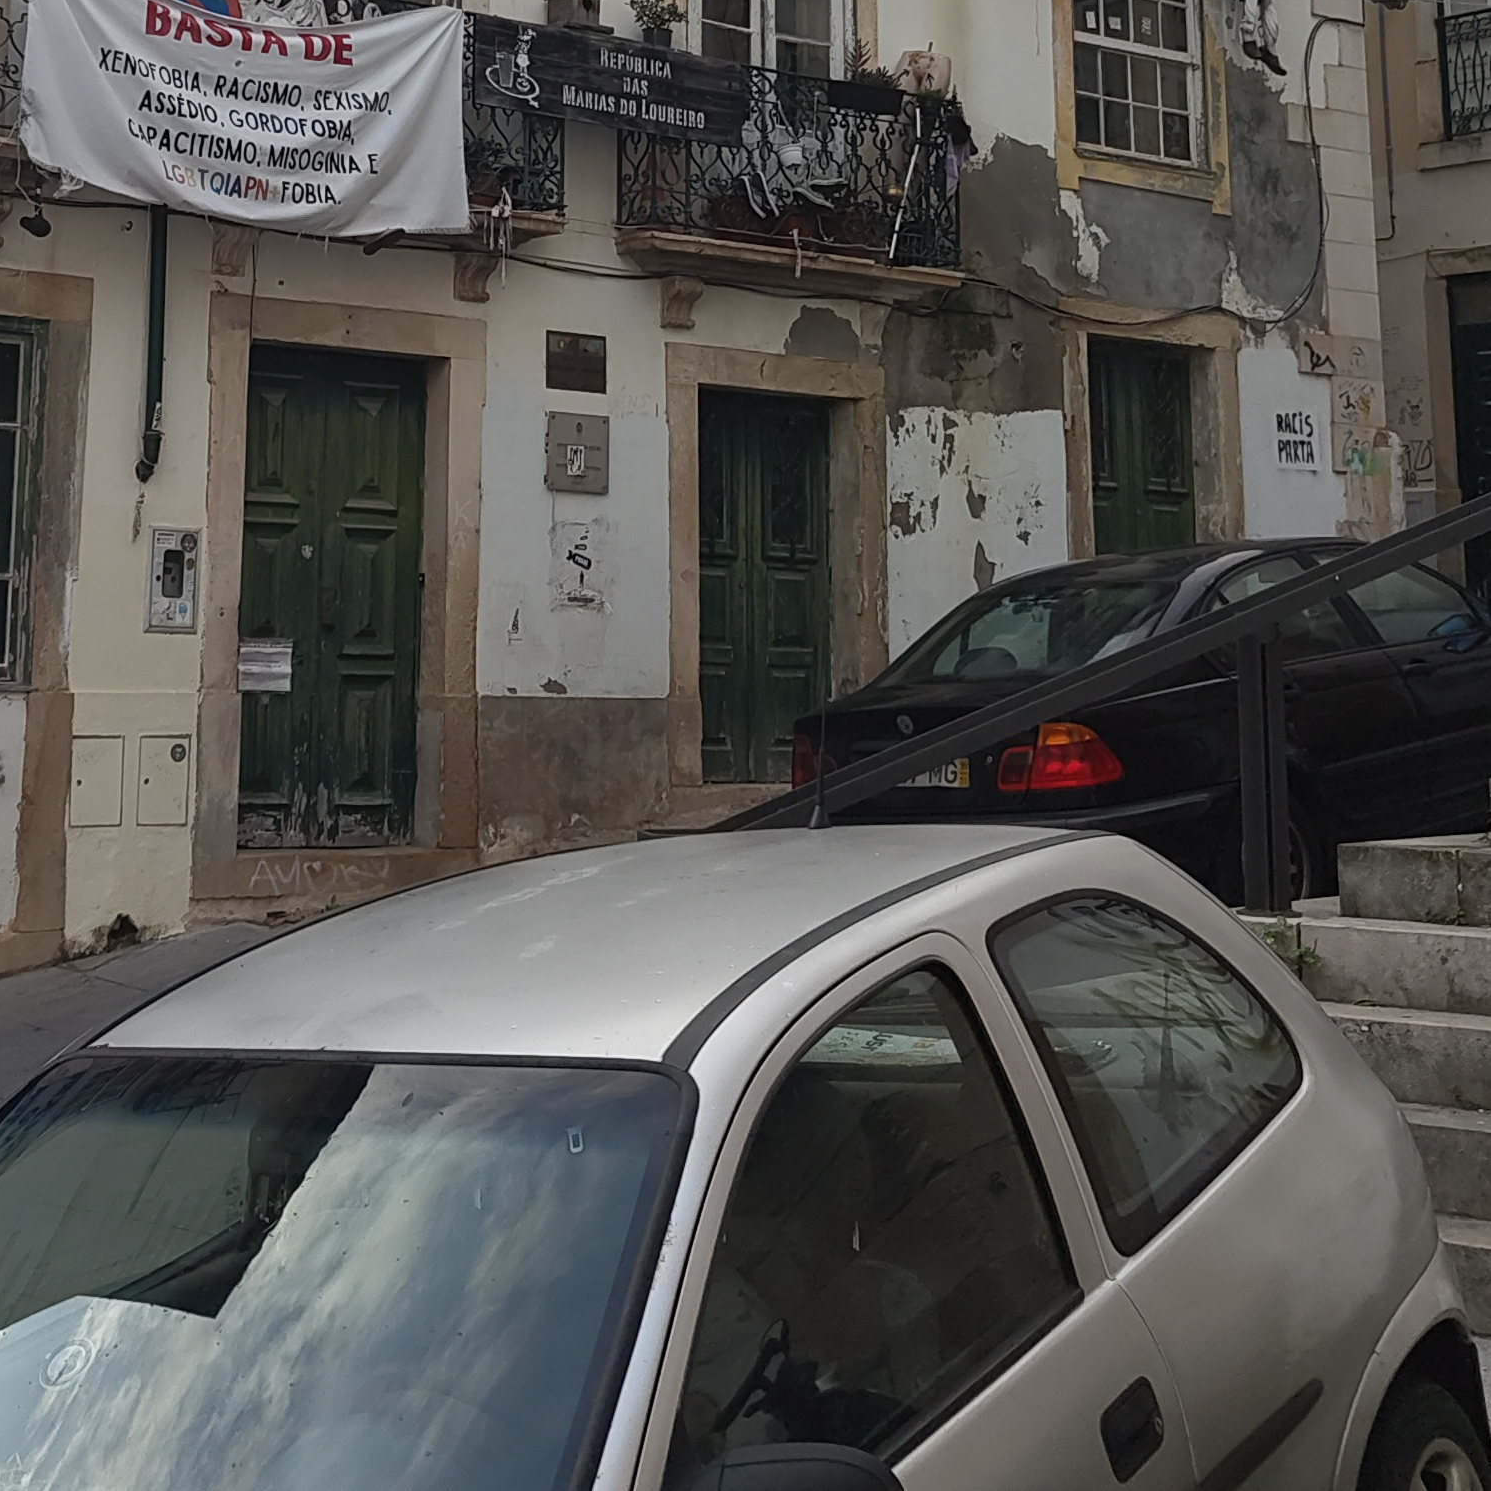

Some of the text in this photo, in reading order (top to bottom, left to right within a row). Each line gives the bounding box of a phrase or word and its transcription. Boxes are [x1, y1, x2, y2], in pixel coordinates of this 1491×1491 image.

[145, 0, 354, 67] BASTA DE
[98, 46, 393, 116] XENOFOBIA, RACISMO, SEXISMO,
[600, 46, 673, 80] REPÚBLICA
[562, 83, 706, 130] MARIAS DO LOUREIRO
[622, 76, 649, 97] DAS
[267, 144, 362, 176] MISOGINIA
[367, 153, 380, 175] E
